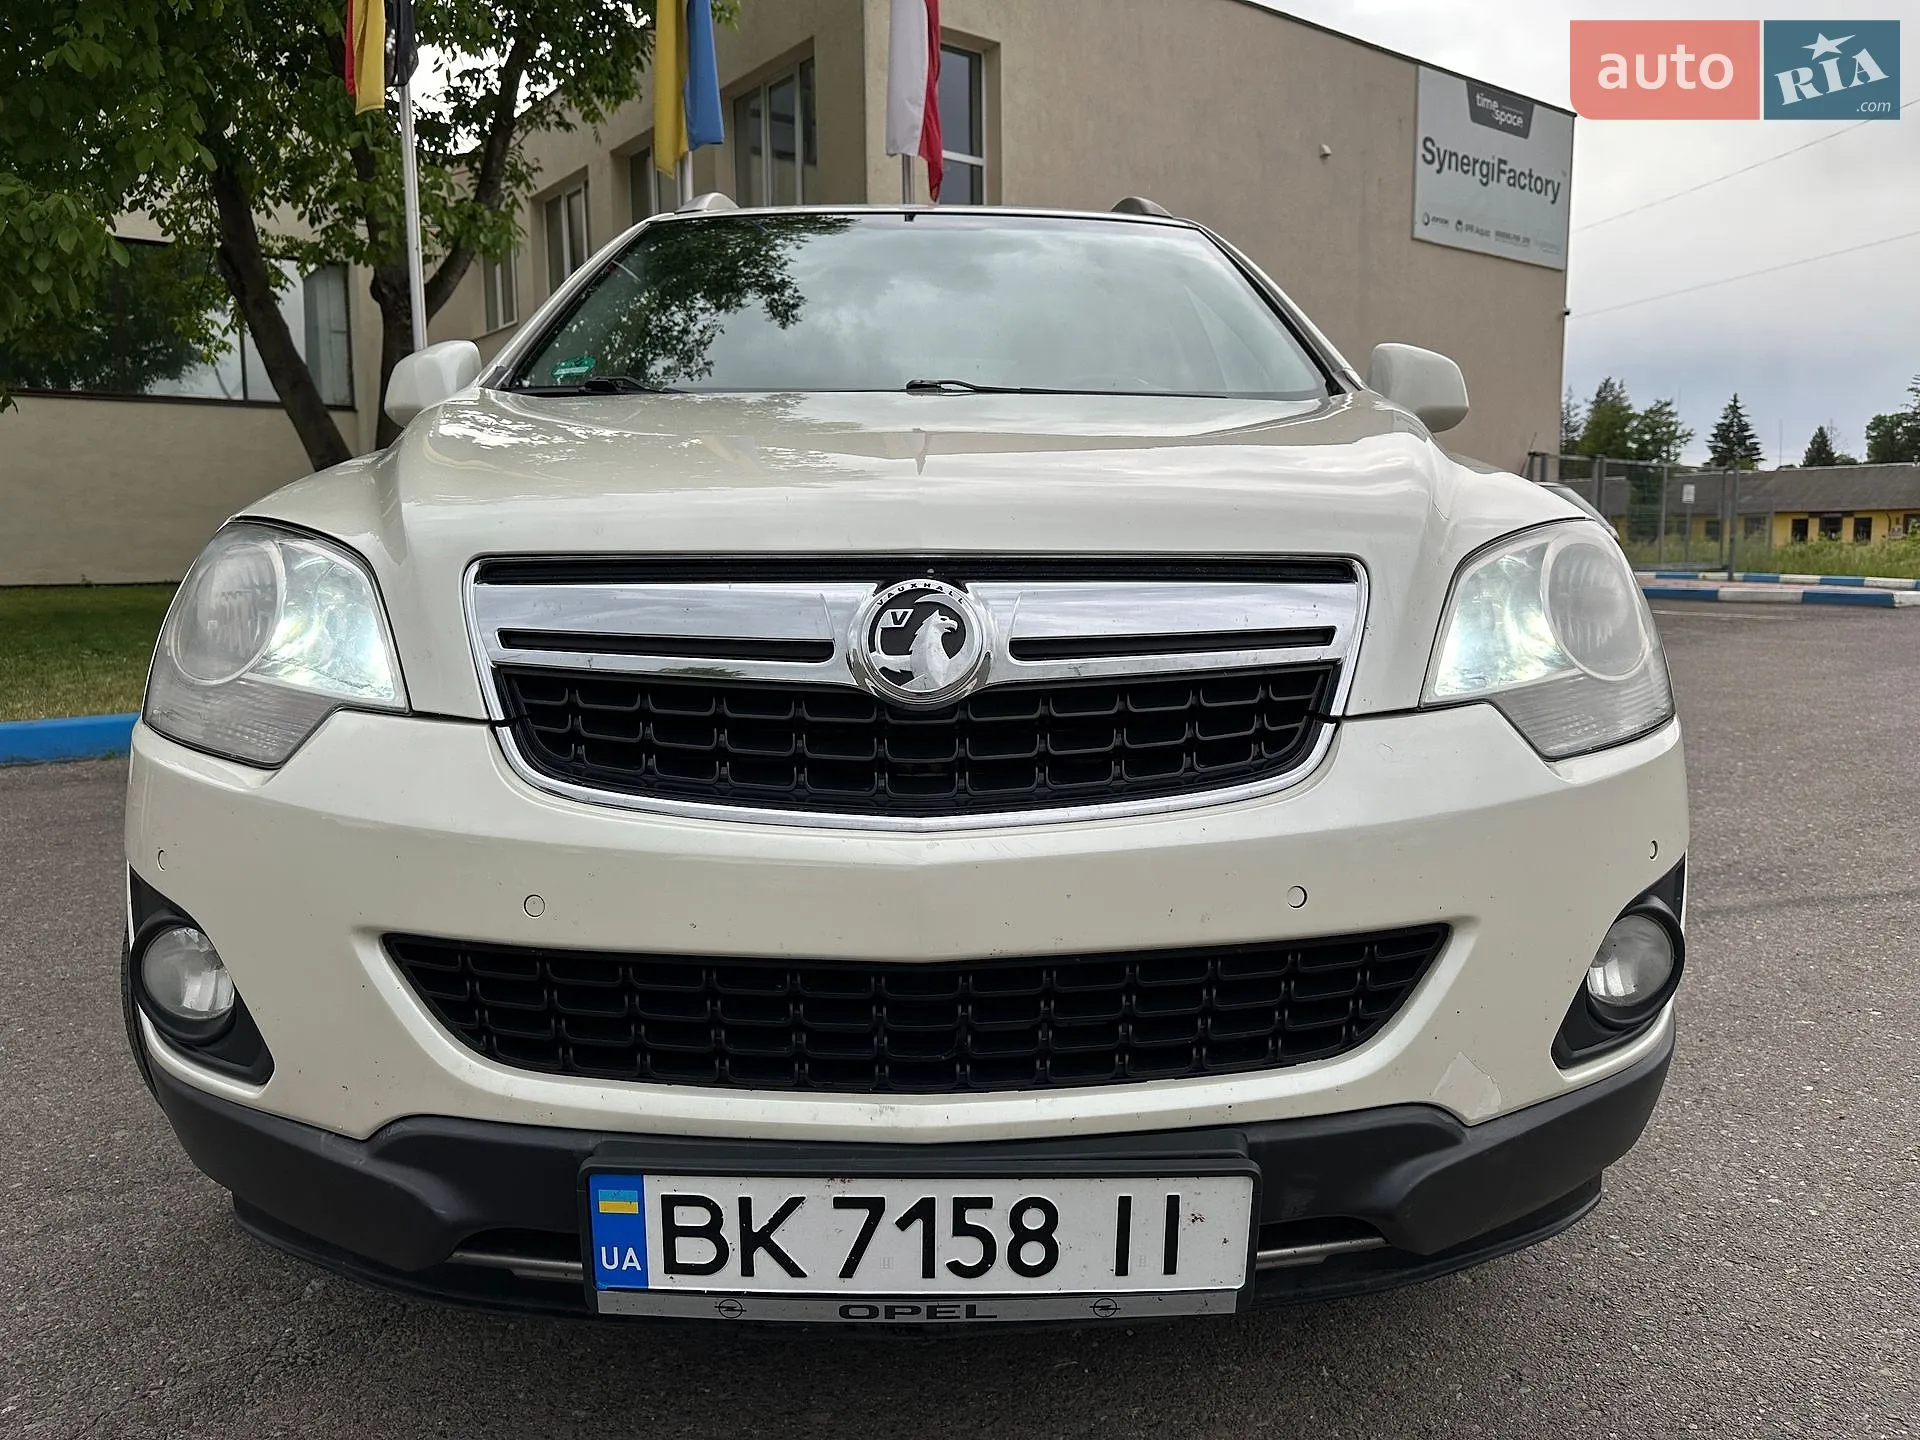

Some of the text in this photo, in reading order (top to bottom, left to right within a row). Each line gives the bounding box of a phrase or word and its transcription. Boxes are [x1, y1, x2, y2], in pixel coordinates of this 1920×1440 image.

[1475, 92, 1499, 110] time
[1421, 136, 1561, 205] SynergiFactory
[876, 582, 965, 606] VAUXHALL
[890, 610, 909, 626] V
[660, 1193, 1181, 1279] BK 7158 II
[600, 1246, 642, 1271] UA
[838, 1304, 998, 1320] OPEL
